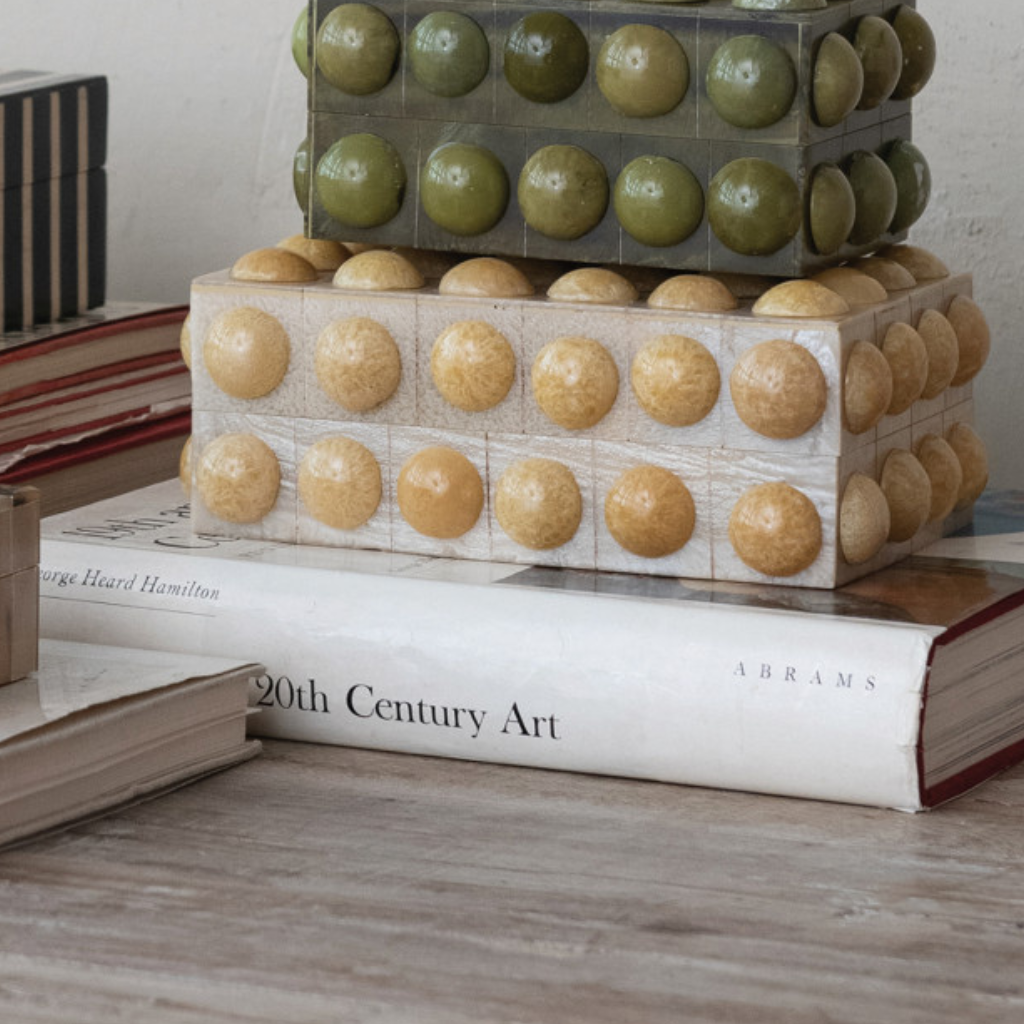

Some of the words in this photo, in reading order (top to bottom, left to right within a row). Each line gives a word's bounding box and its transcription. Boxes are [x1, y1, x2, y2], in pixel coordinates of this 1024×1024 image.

[80, 568, 138, 591] Heard
[139, 574, 220, 601] Hamilton
[732, 660, 878, 692] ABRAMS
[255, 674, 330, 714] 20th
[346, 682, 487, 739] Century
[500, 700, 562, 741] Art
